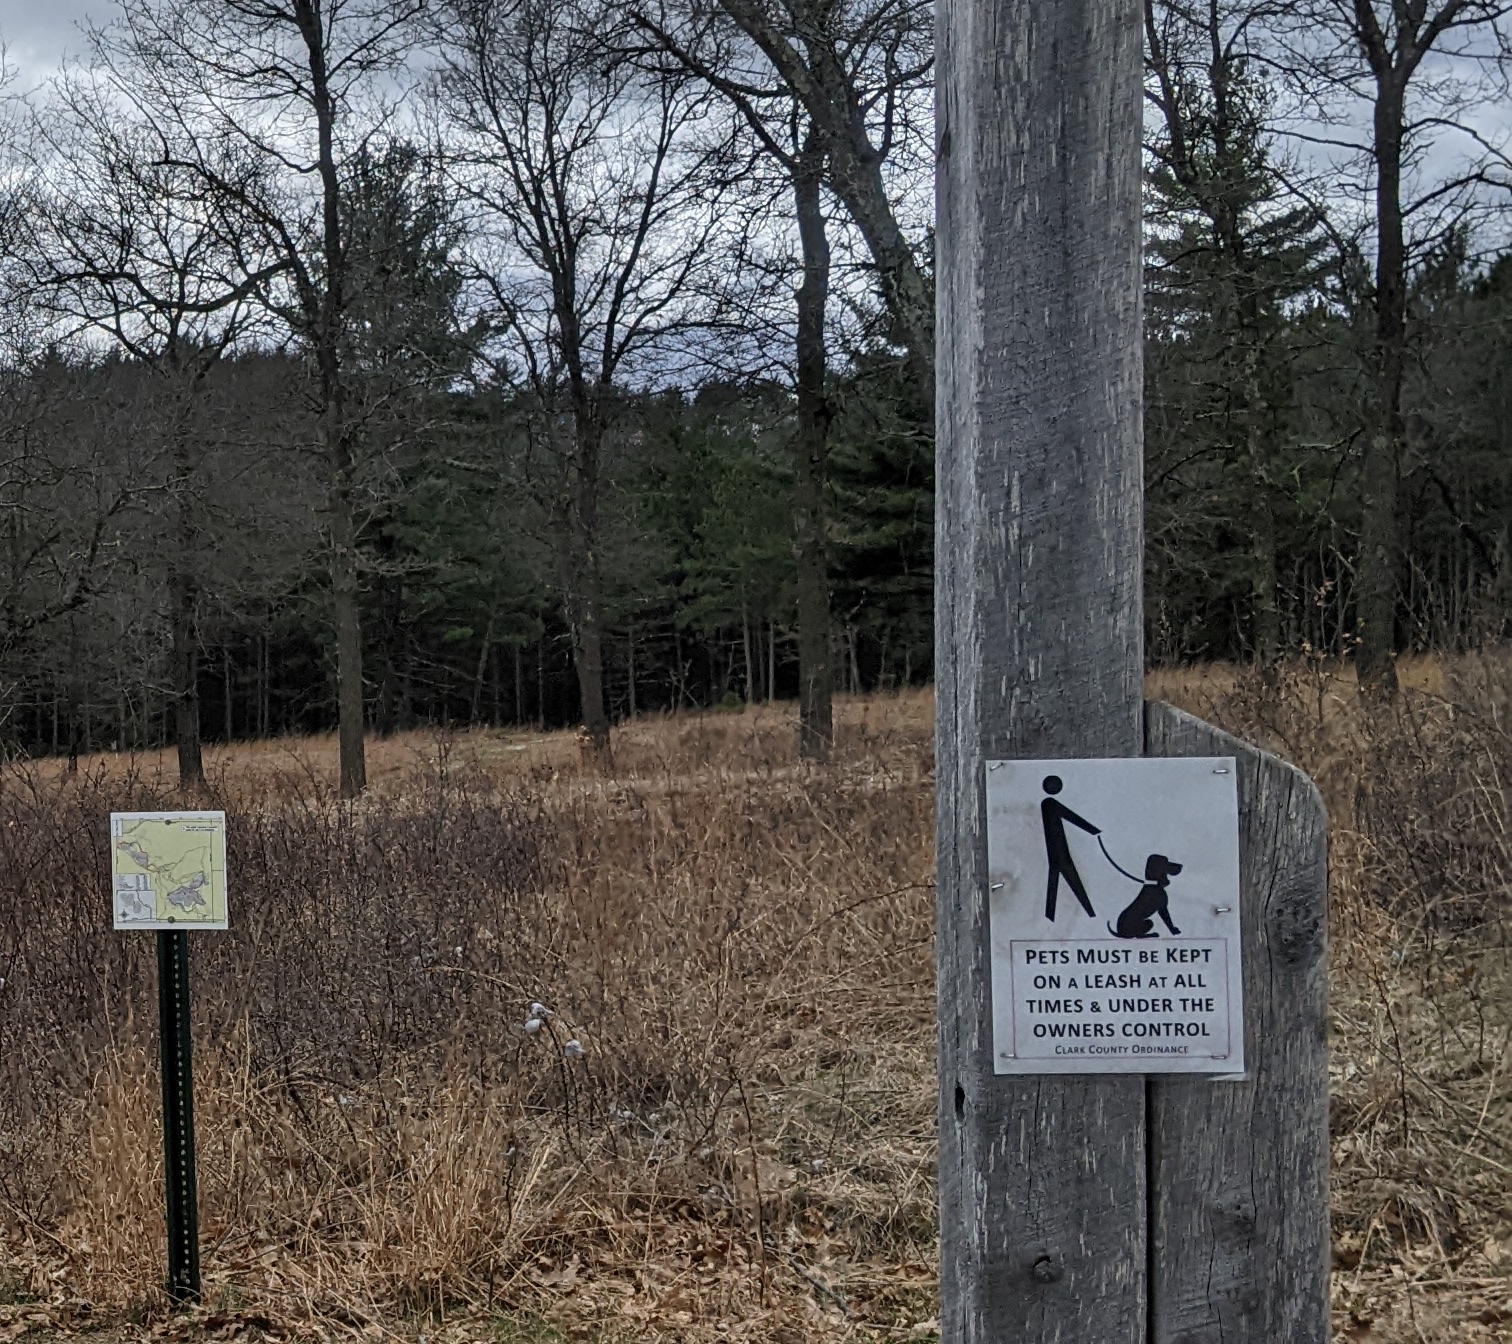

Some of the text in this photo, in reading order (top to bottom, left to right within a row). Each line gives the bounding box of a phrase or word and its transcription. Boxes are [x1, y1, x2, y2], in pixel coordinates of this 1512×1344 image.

[1025, 948, 1212, 965] PETS MUST BE KEPT
[1033, 973, 1206, 989] ON A LEASH AT ALL
[1026, 997, 1215, 1014] TIMES & UNDER THE
[1033, 1022, 1210, 1038] OWNERS CONTROL
[1055, 1045, 1085, 1055] CLARK
[1088, 1044, 1129, 1055] COUNTY
